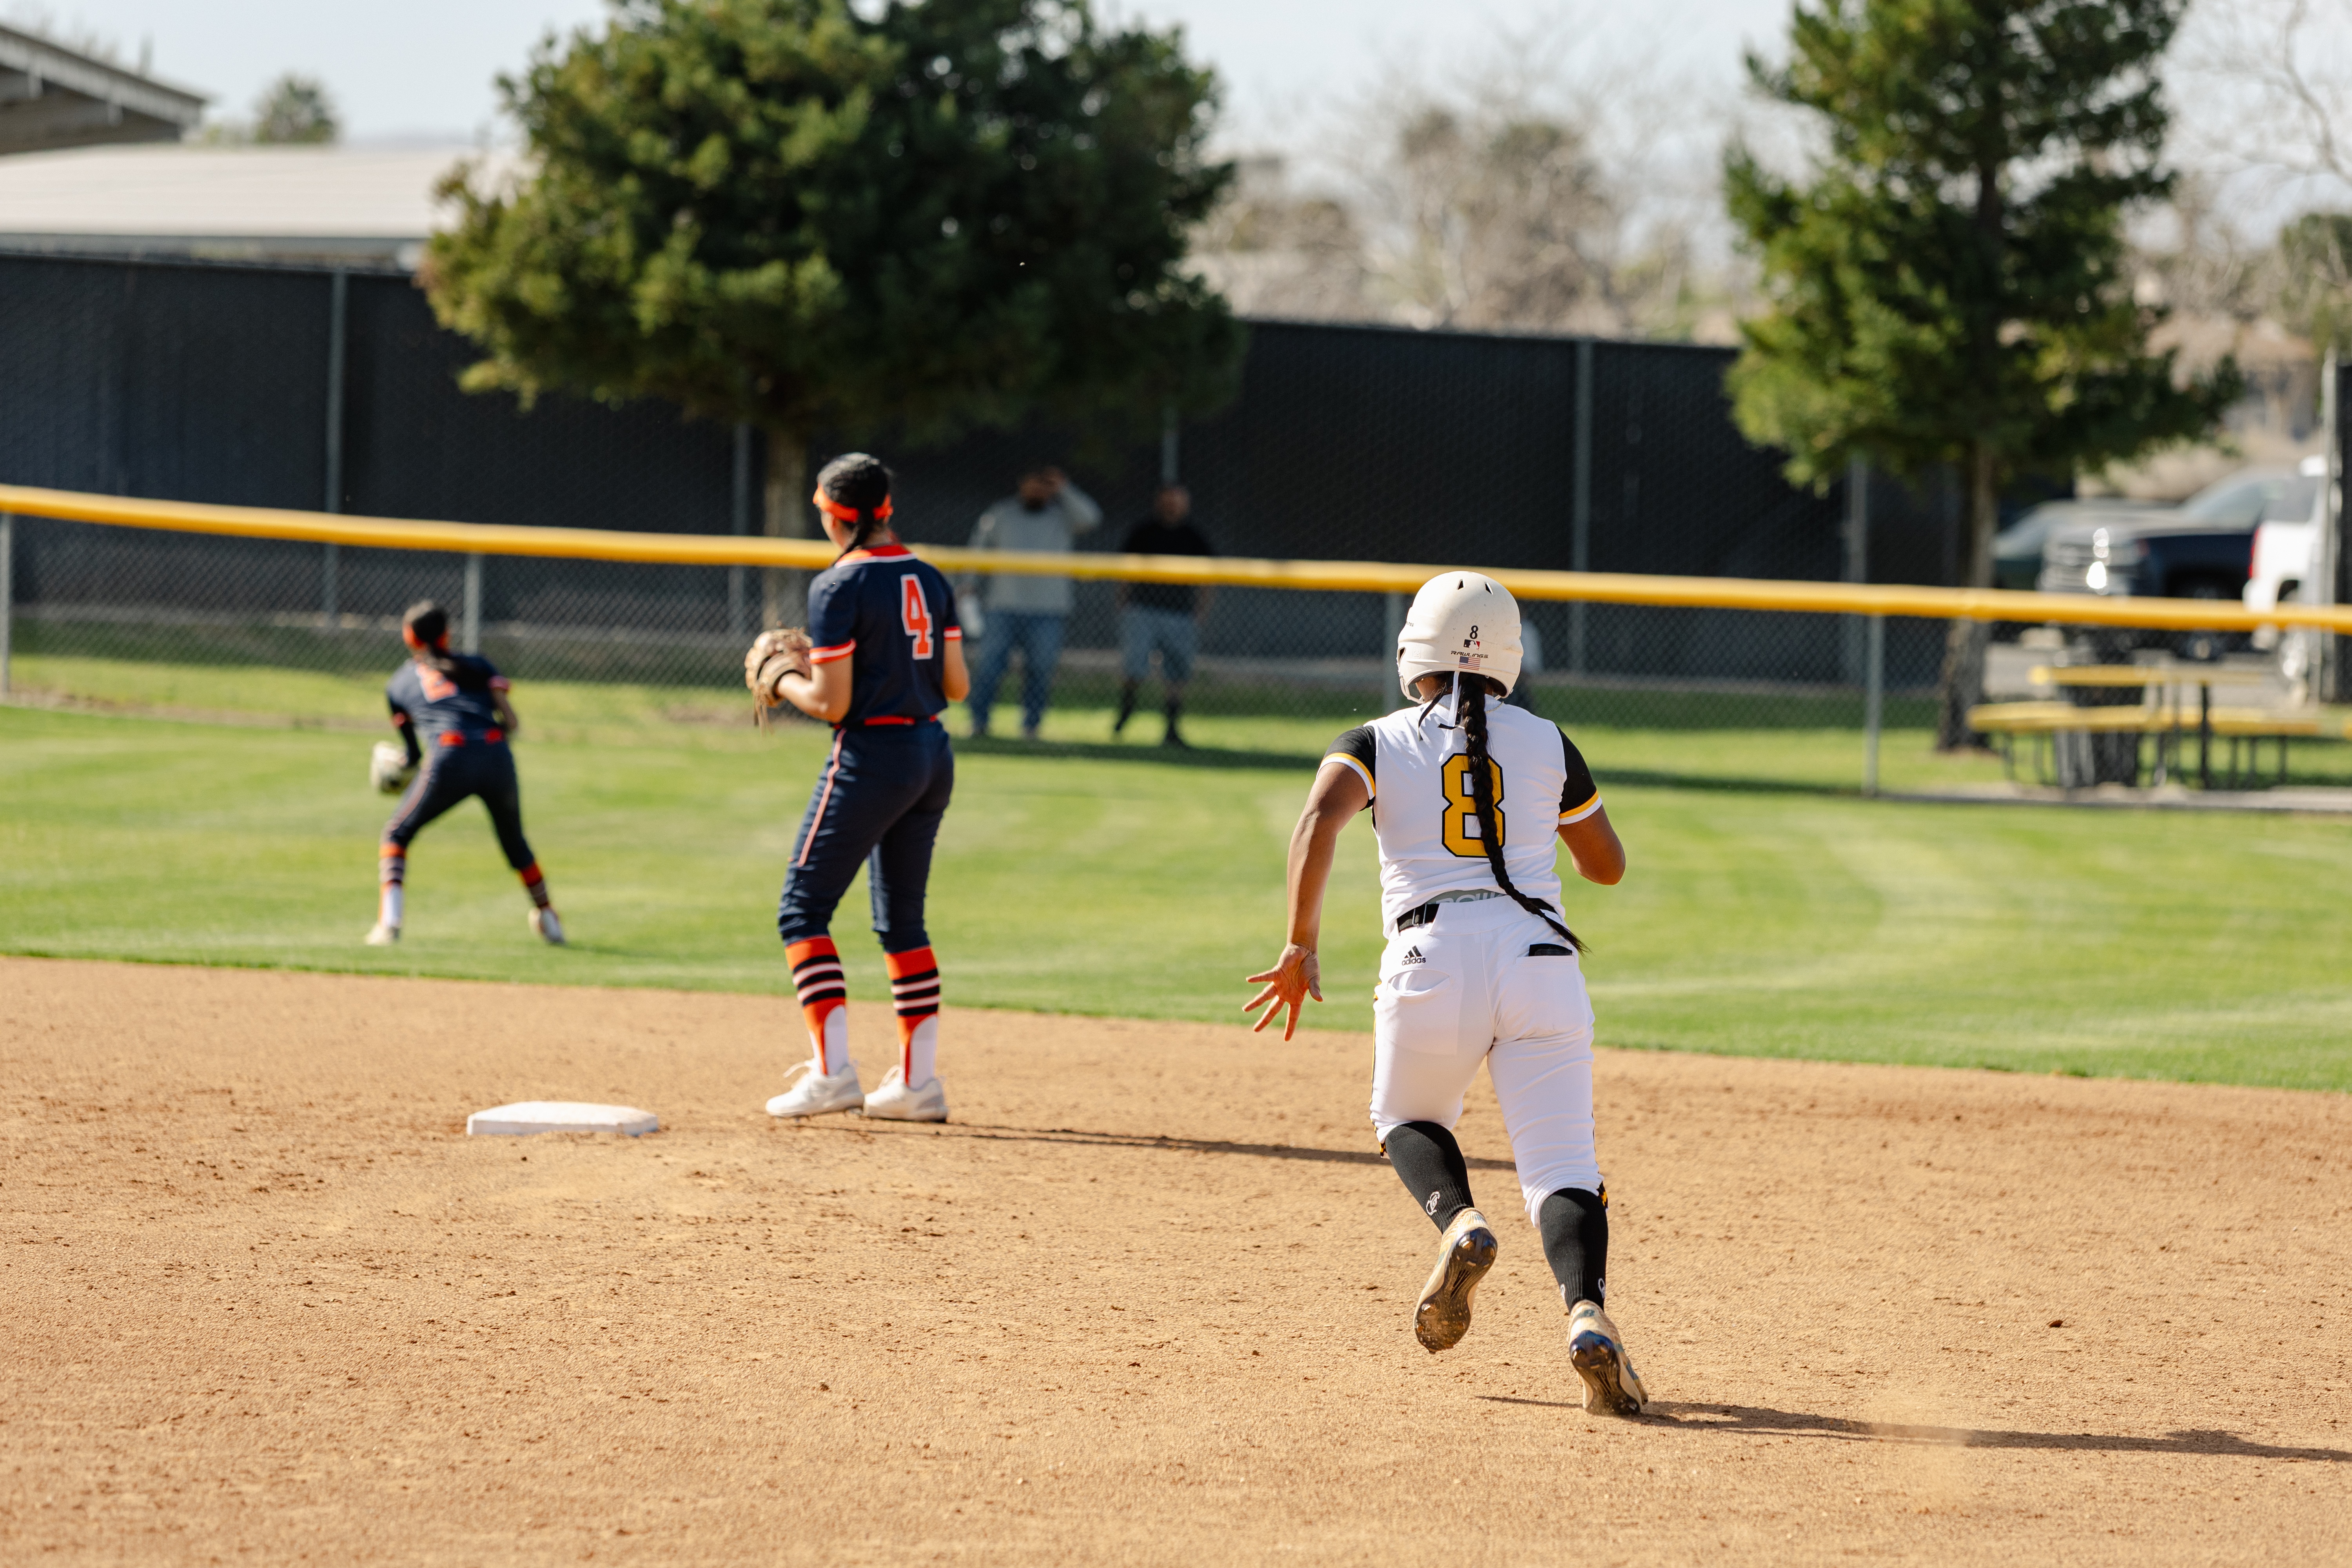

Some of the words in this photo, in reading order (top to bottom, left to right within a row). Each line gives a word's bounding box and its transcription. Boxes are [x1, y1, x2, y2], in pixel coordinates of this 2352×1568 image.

[901, 574, 933, 659] 4
[1470, 625, 1478, 639] 8
[1441, 753, 1505, 858] 8
[1402, 957, 1426, 965] adidas
